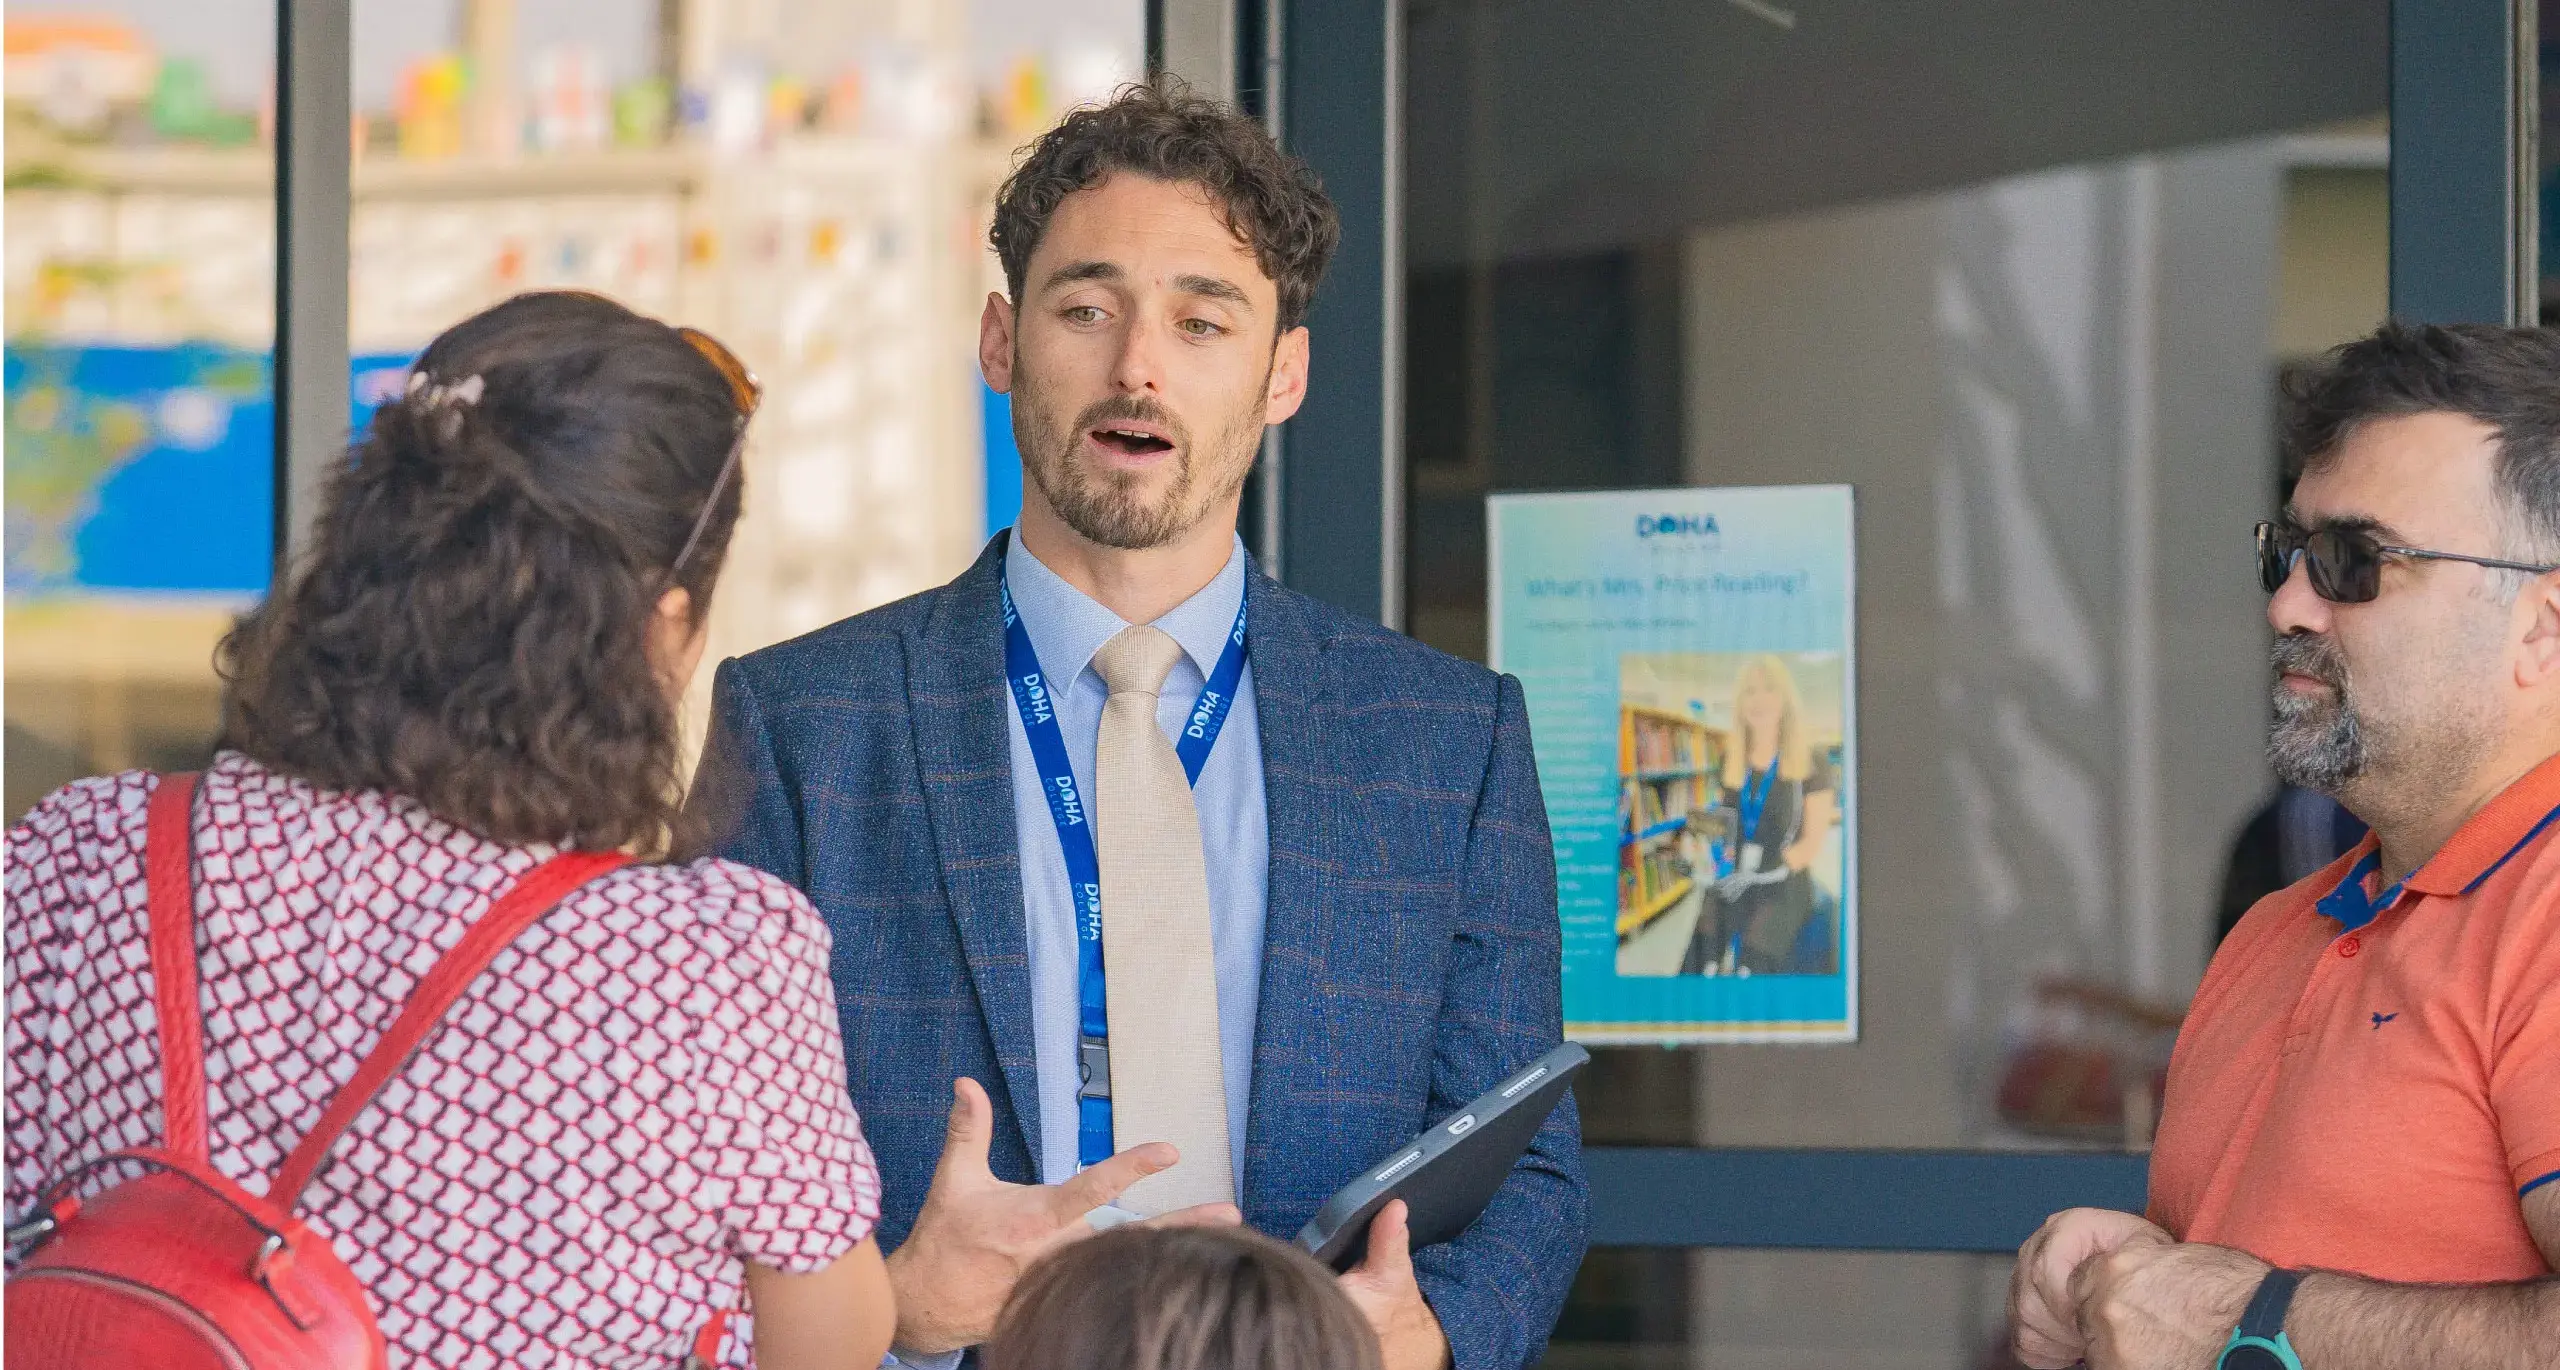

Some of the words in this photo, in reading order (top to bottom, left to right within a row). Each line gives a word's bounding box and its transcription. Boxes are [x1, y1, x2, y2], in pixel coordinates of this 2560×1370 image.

[1635, 513, 1720, 538] DOHA
[1000, 577, 1016, 629] DOHA
[1526, 577, 1597, 598] What's
[1013, 678, 1036, 728] COLLEGE
[1023, 672, 1052, 724] DOHA
[1187, 690, 1221, 739] DOHA
[1206, 696, 1230, 742] COLLEGE
[1045, 778, 1067, 826] COLLEGE
[1056, 775, 1083, 826] DOHA
[1075, 882, 1088, 941] COLLEGE
[1084, 883, 1101, 941] DOHA
